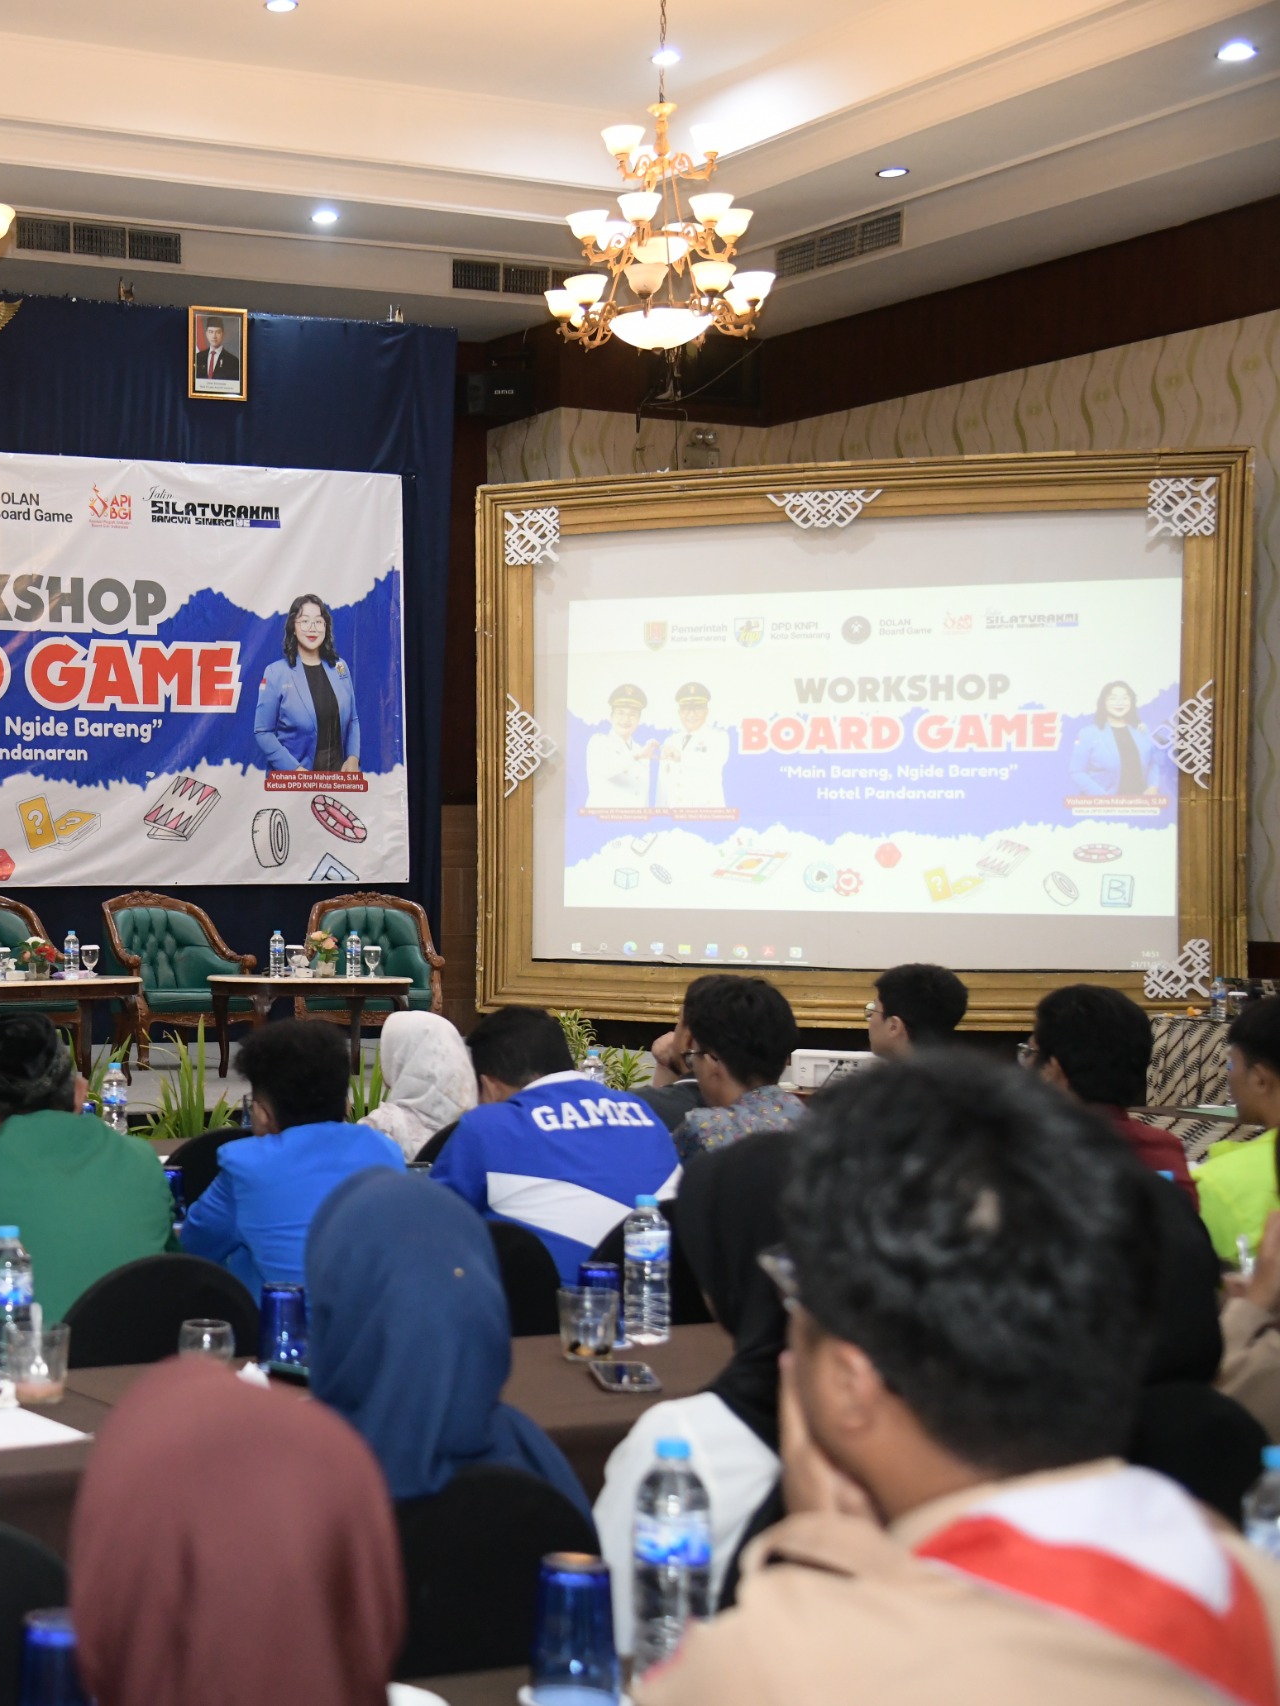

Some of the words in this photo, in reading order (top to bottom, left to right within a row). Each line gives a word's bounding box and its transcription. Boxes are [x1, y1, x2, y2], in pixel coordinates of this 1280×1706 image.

[110, 494, 131, 507] API
[34, 510, 73, 523] Game
[110, 507, 131, 520] BGI
[671, 623, 728, 634] Pemerintah
[771, 622, 792, 632] DPD
[795, 621, 818, 631] KNPI
[879, 618, 911, 627] DOLAN
[771, 632, 788, 641] Kota
[790, 631, 831, 641] Semarang
[879, 627, 905, 636] Board
[907, 626, 933, 636] Game
[671, 634, 688, 643] Kota
[690, 634, 727, 643] Semarang
[30, 642, 235, 707] GAME
[793, 673, 1010, 704] WORKSHOP
[6, 717, 68, 739] Ngide
[741, 716, 900, 751] BOARD
[917, 712, 1058, 750] GAME
[314, 773, 346, 781] Mahardika,
[830, 765, 892, 781] Bareng,
[897, 764, 944, 780] Ngide
[817, 787, 860, 799] Hotel
[864, 786, 965, 800] Pandanaran
[531, 1098, 655, 1131] GAMKI
